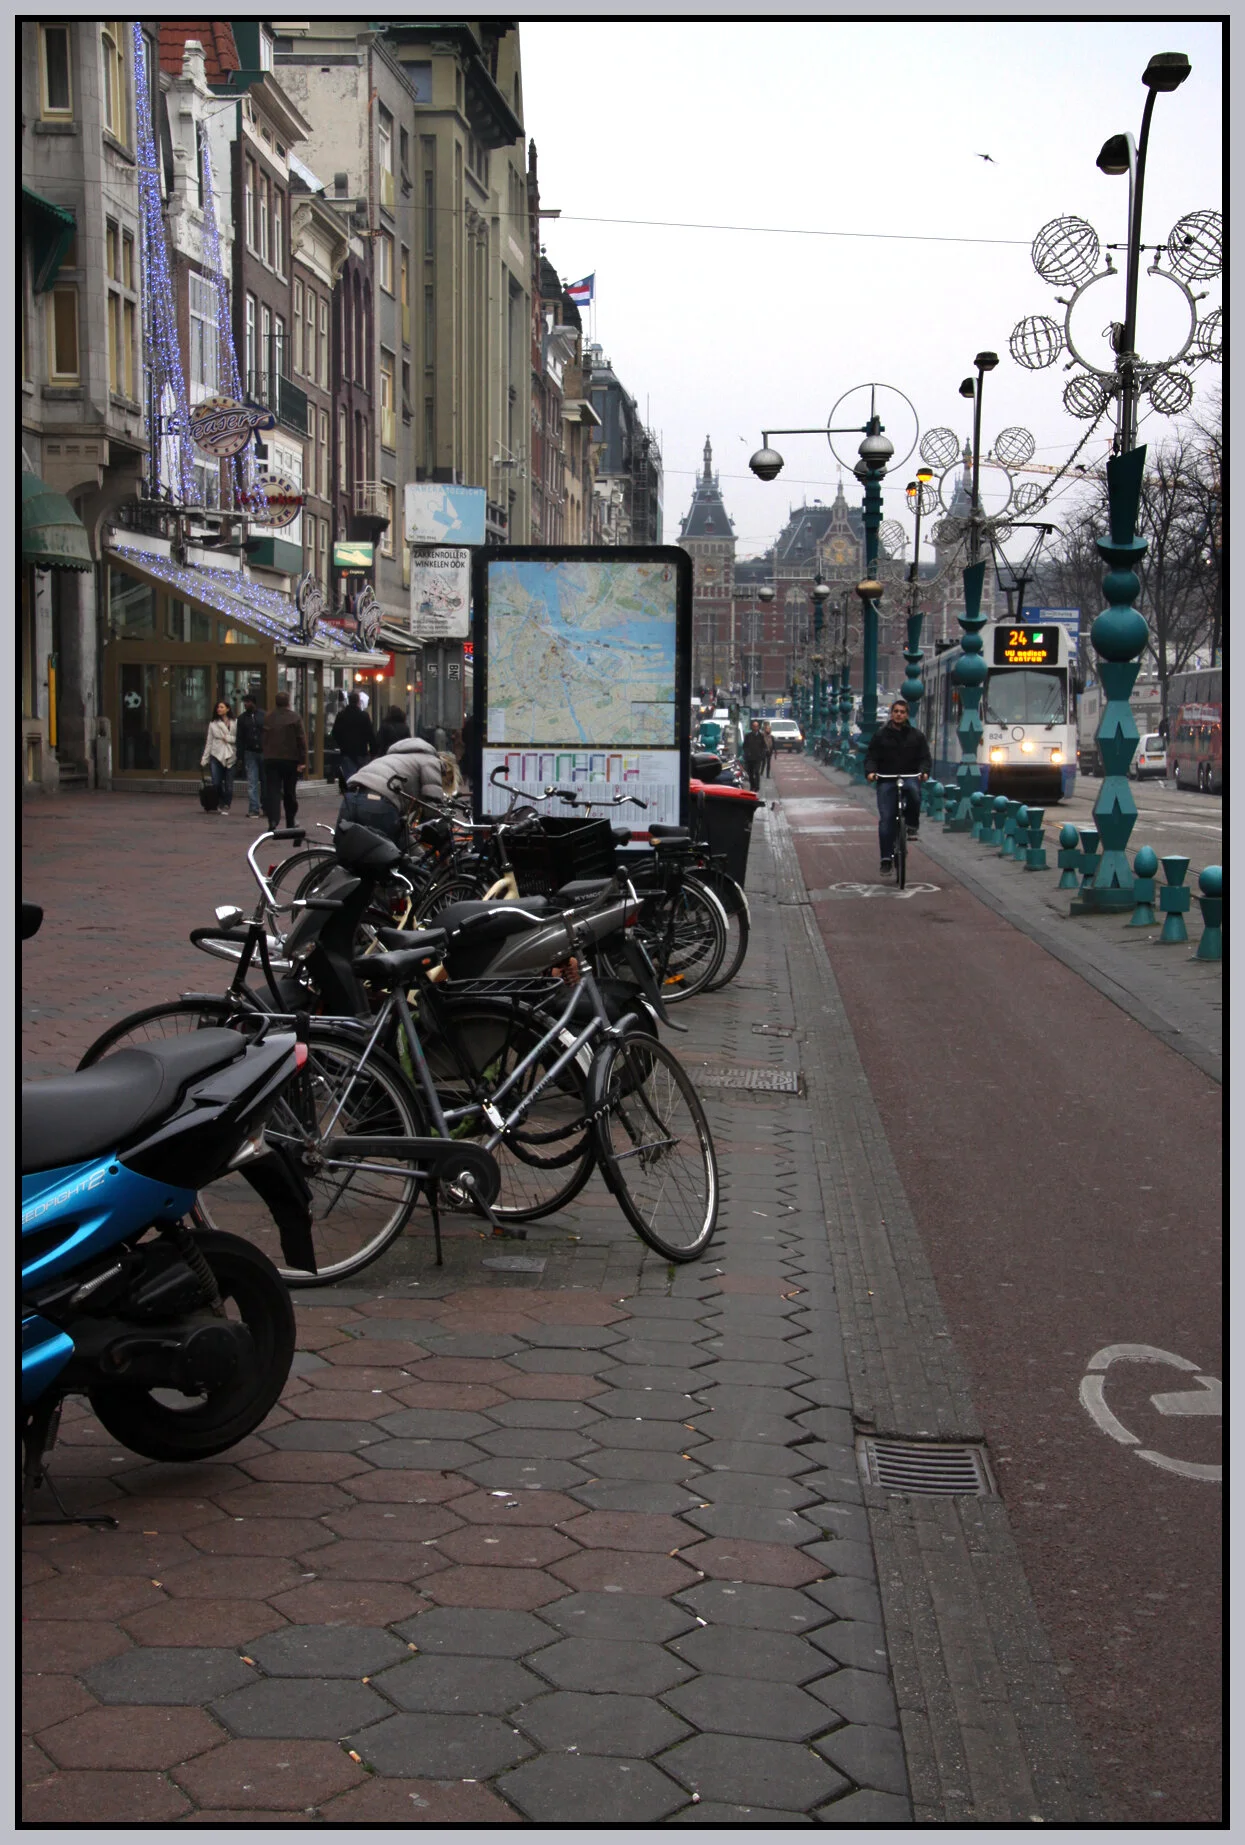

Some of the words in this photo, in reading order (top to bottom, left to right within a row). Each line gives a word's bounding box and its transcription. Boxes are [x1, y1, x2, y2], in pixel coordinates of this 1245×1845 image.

[413, 551, 467, 559] ZAKKENROLLERS
[415, 560, 450, 568] WINKELEN
[1009, 630, 1028, 646] 24
